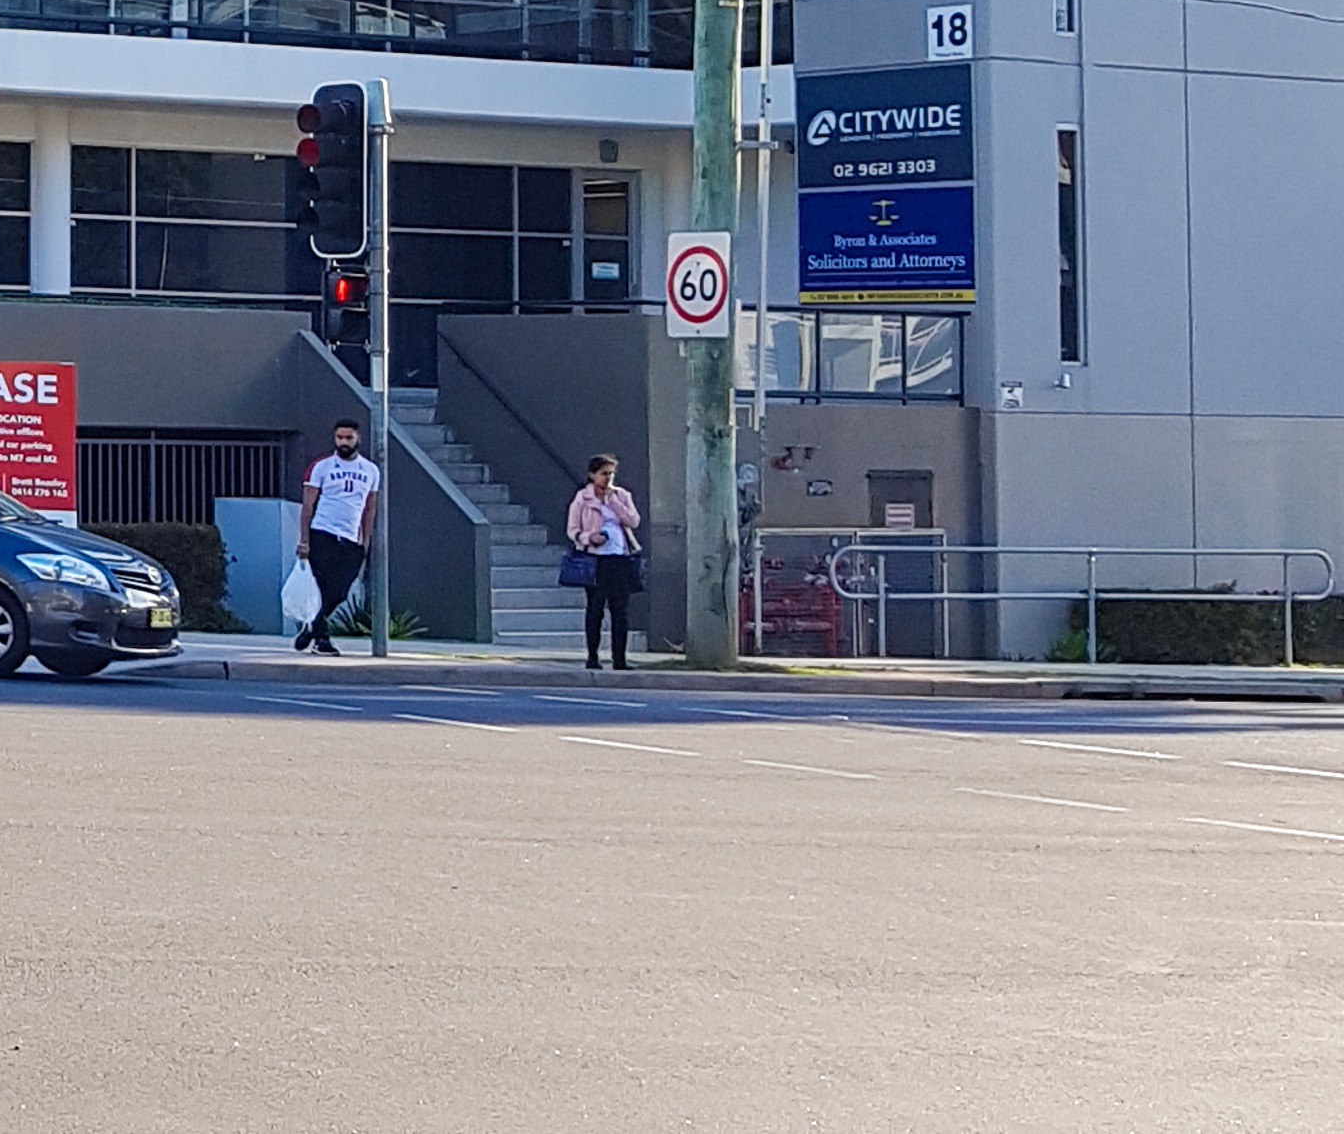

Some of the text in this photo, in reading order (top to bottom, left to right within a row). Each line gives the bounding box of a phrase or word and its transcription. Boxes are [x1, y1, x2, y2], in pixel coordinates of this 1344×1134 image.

[931, 11, 968, 47] 18
[838, 104, 962, 134] CITYWIDE
[833, 159, 936, 178] 02 9621 3303
[833, 232, 937, 250] Byron & Associates
[807, 252, 967, 271] Solicitors and Attorneys
[679, 268, 718, 302] 60
[21, 441, 53, 452] parking
[0, 453, 9, 461] to
[25, 454, 41, 463] and
